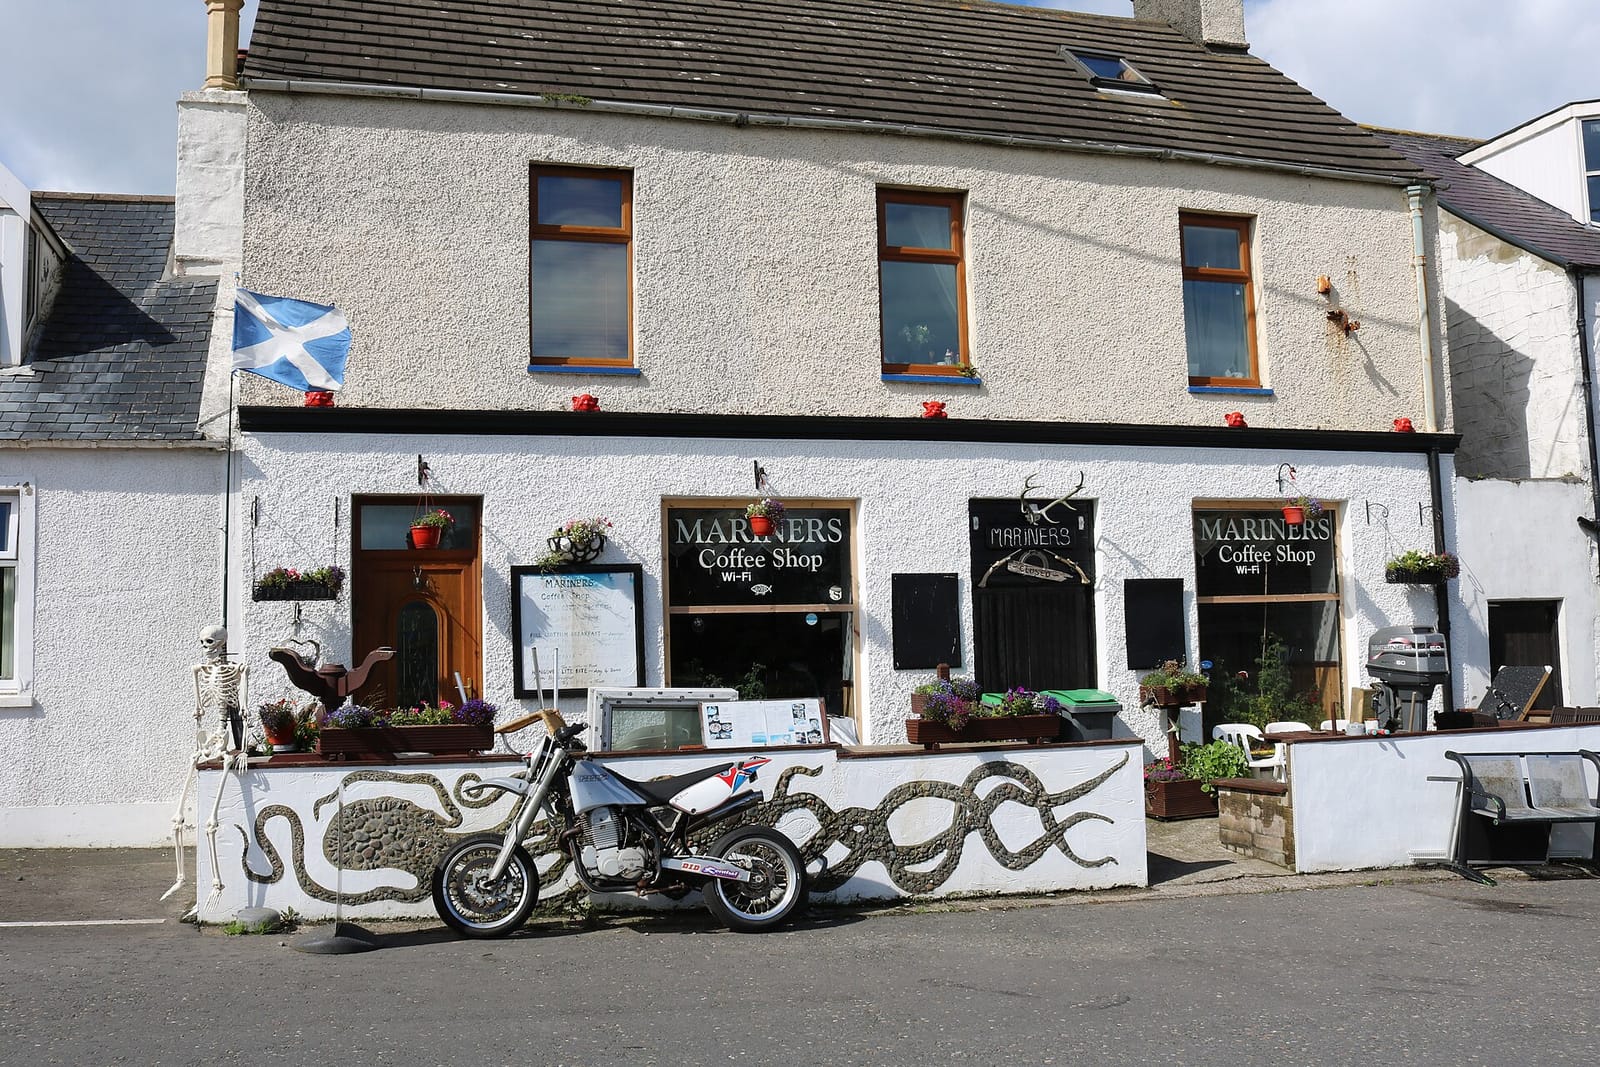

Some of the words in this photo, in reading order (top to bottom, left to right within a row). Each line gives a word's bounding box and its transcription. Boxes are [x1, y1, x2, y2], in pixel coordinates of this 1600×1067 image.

[1200, 518, 1330, 540] MARINERS
[699, 548, 766, 569] Coffee
[772, 548, 823, 572] Shop
[1219, 544, 1272, 563] Coffee
[1276, 544, 1316, 566] Shop
[1019, 564, 1051, 577] CLOSED
[1235, 565, 1260, 575] Wi-Fi
[721, 571, 752, 582] Wi-Fi
[545, 579, 594, 589] MARINERS
[682, 863, 700, 871] DID
